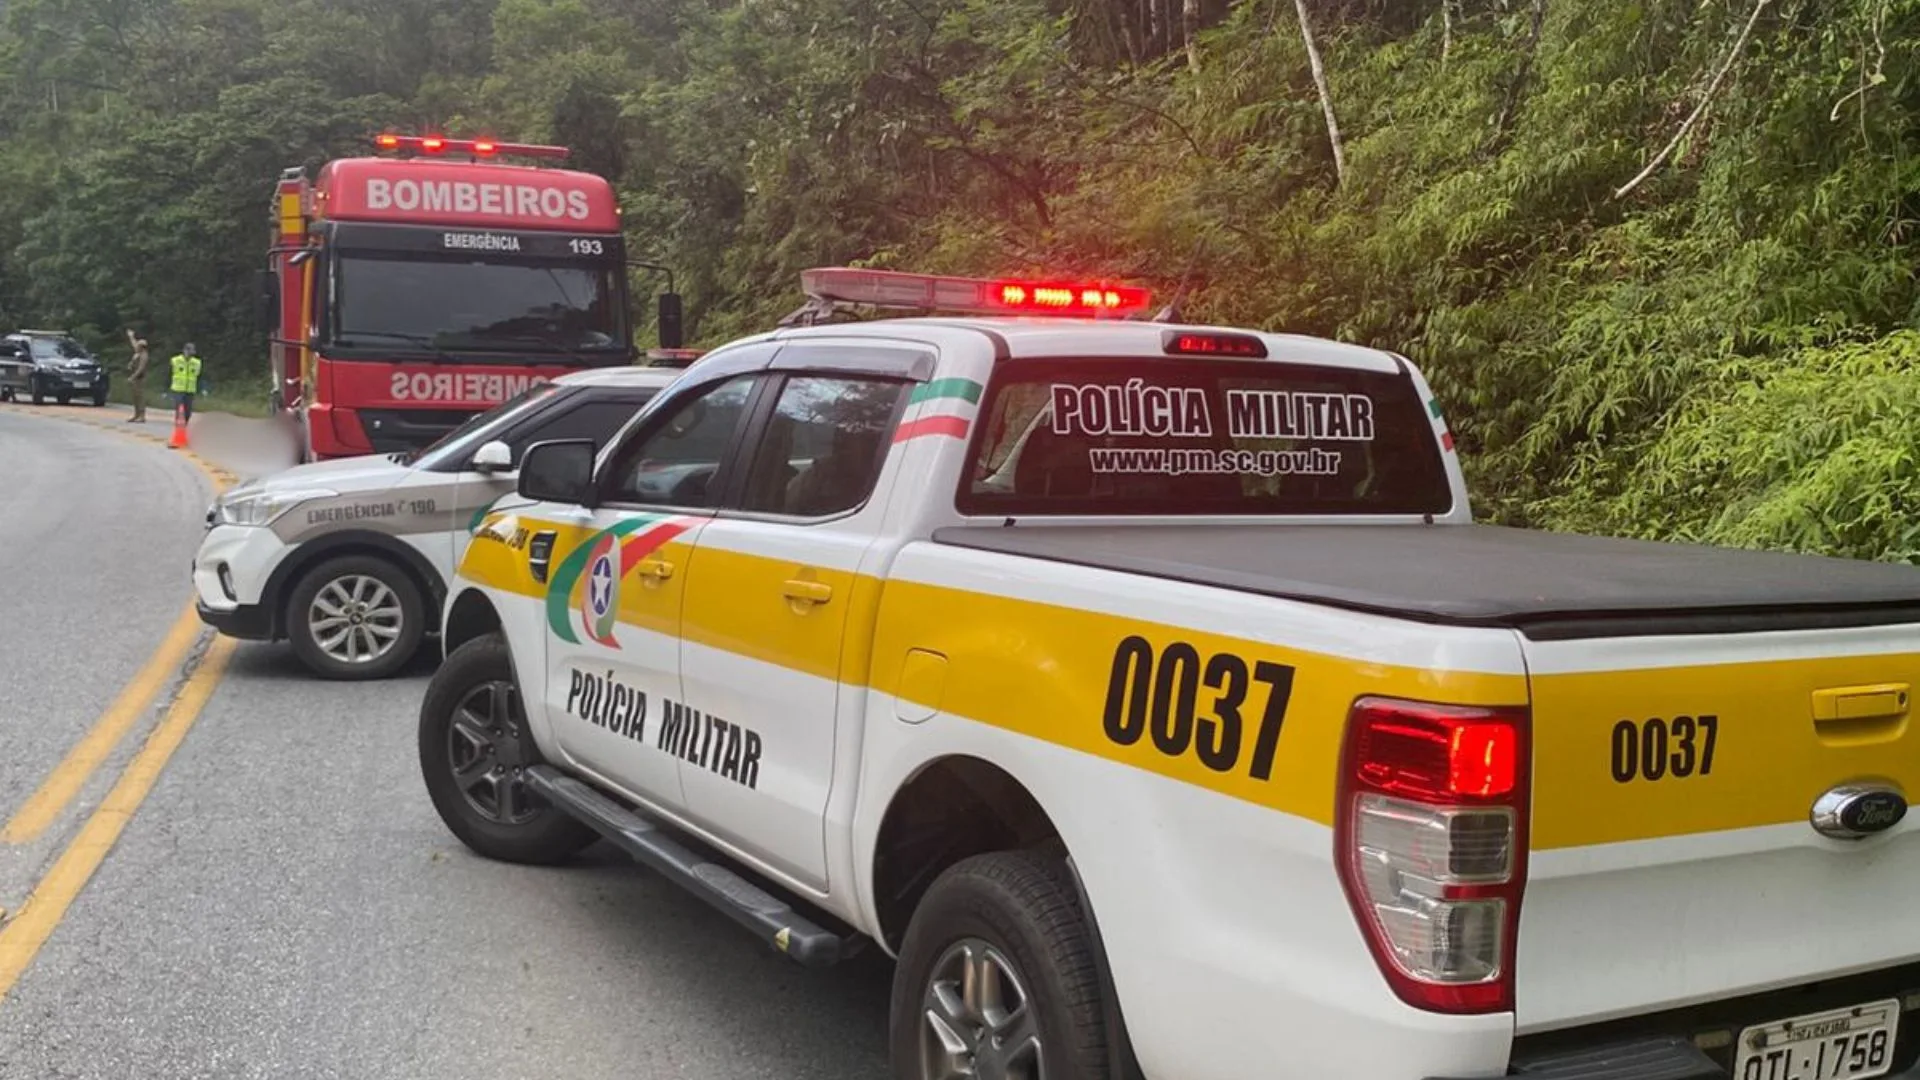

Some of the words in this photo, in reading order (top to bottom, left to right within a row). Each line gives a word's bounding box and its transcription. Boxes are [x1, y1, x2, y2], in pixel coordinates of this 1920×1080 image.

[366, 179, 589, 220] BOMBEIROS
[444, 232, 520, 251] EMERGÊNCIA
[568, 239, 603, 255] 193
[1052, 379, 1211, 437] POLÍCIA
[1228, 390, 1375, 441] MILITAR
[1089, 448, 1341, 476] www.pm.sc.gov.br
[307, 502, 395, 524] EMERGÊNCIA
[410, 498, 436, 515] 190
[1103, 635, 1296, 781] 0037
[567, 669, 648, 743] POLÍCIA
[658, 698, 762, 789] MILITAR
[1611, 715, 1718, 783] 0037
[1857, 799, 1896, 825] Ford
